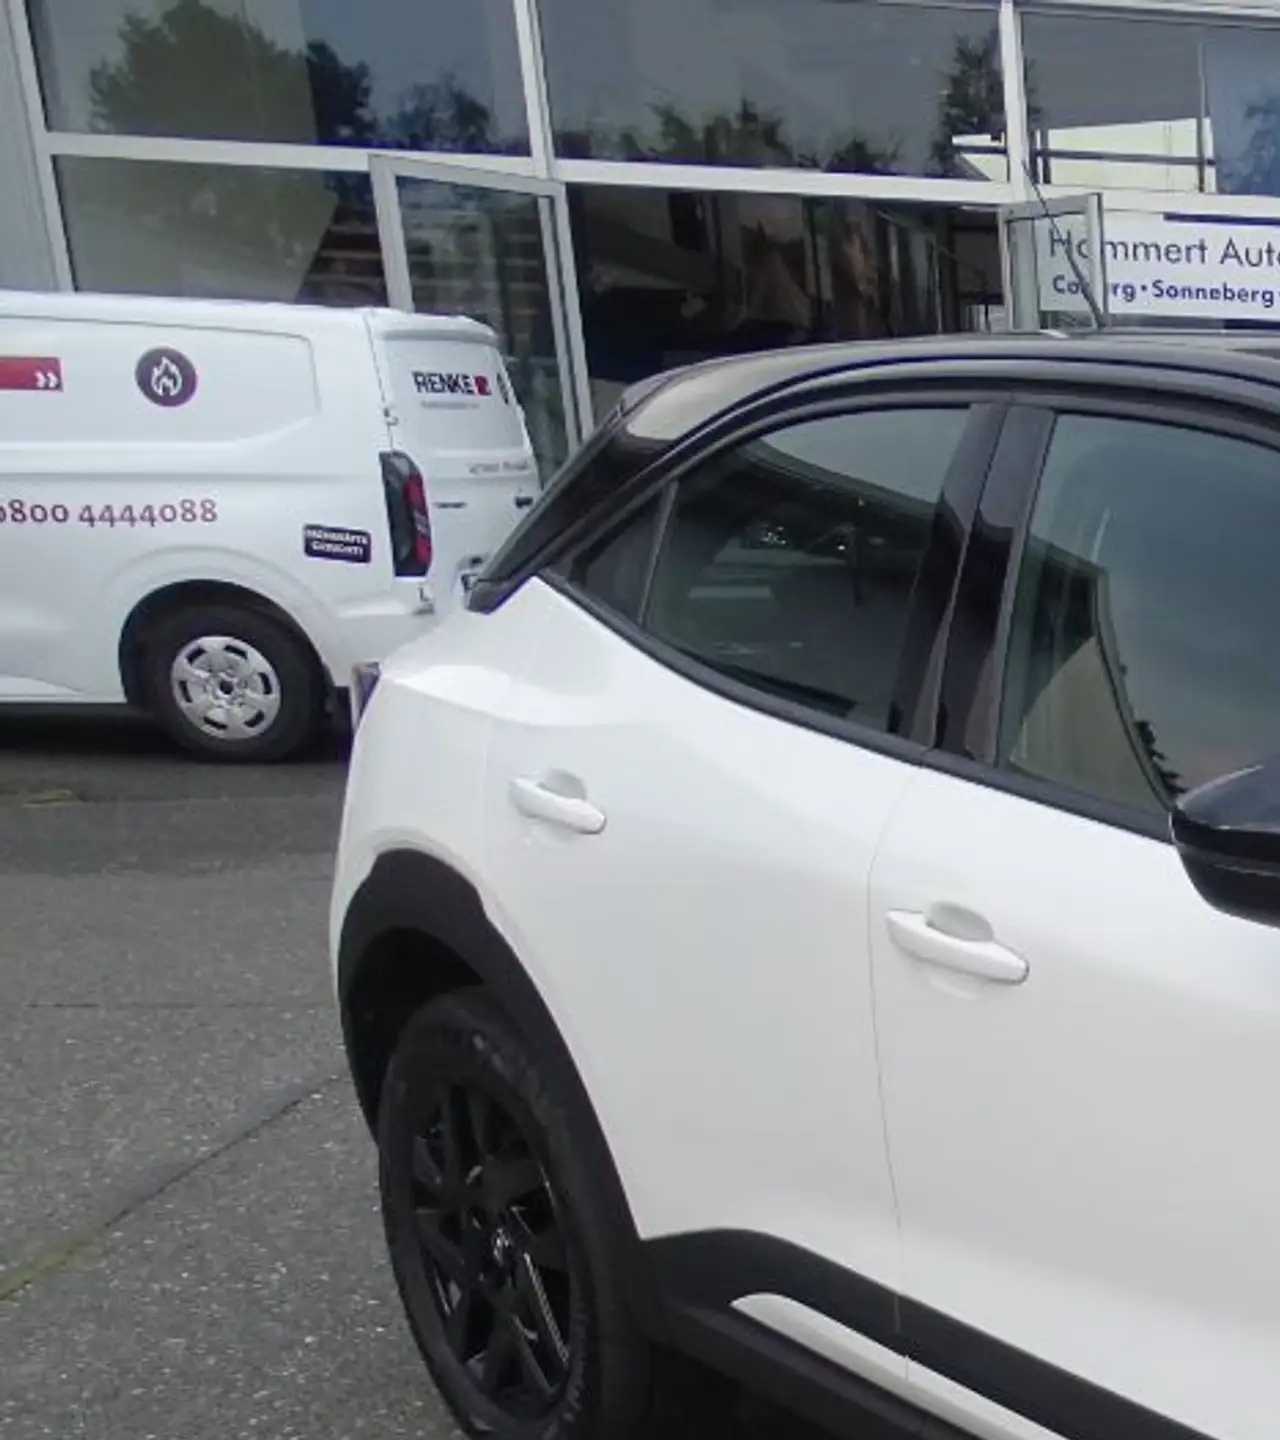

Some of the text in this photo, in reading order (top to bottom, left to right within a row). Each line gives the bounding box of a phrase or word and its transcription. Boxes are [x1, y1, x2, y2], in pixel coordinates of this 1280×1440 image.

[1052, 274, 1137, 303] Corg
[1151, 279, 1275, 309] Sonneberg
[411, 371, 475, 395] RENKE
[78, 499, 218, 528] 4444088
